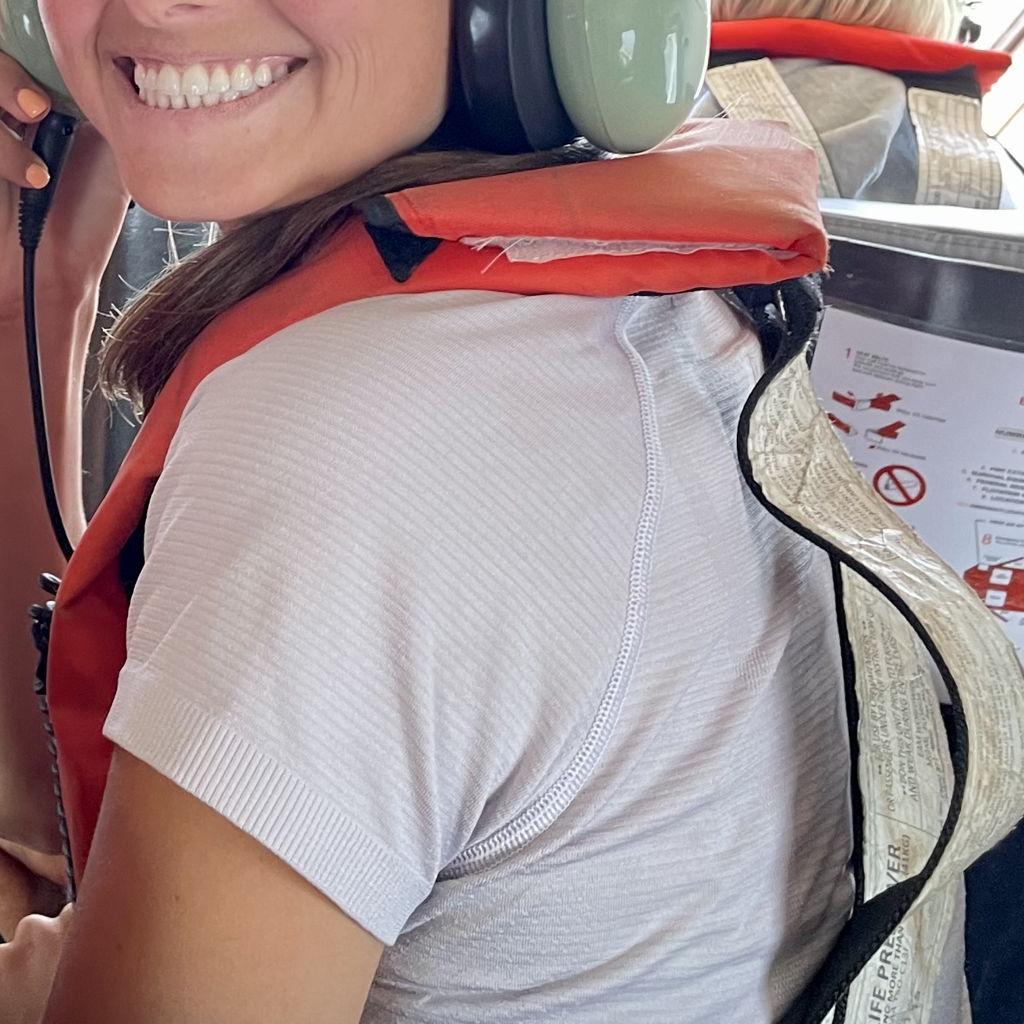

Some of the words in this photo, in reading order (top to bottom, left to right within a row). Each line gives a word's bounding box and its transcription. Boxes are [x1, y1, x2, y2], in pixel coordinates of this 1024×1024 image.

[887, 964, 899, 1002] MORE
[894, 925, 904, 960] THAN
[868, 986, 886, 1024] IFE
